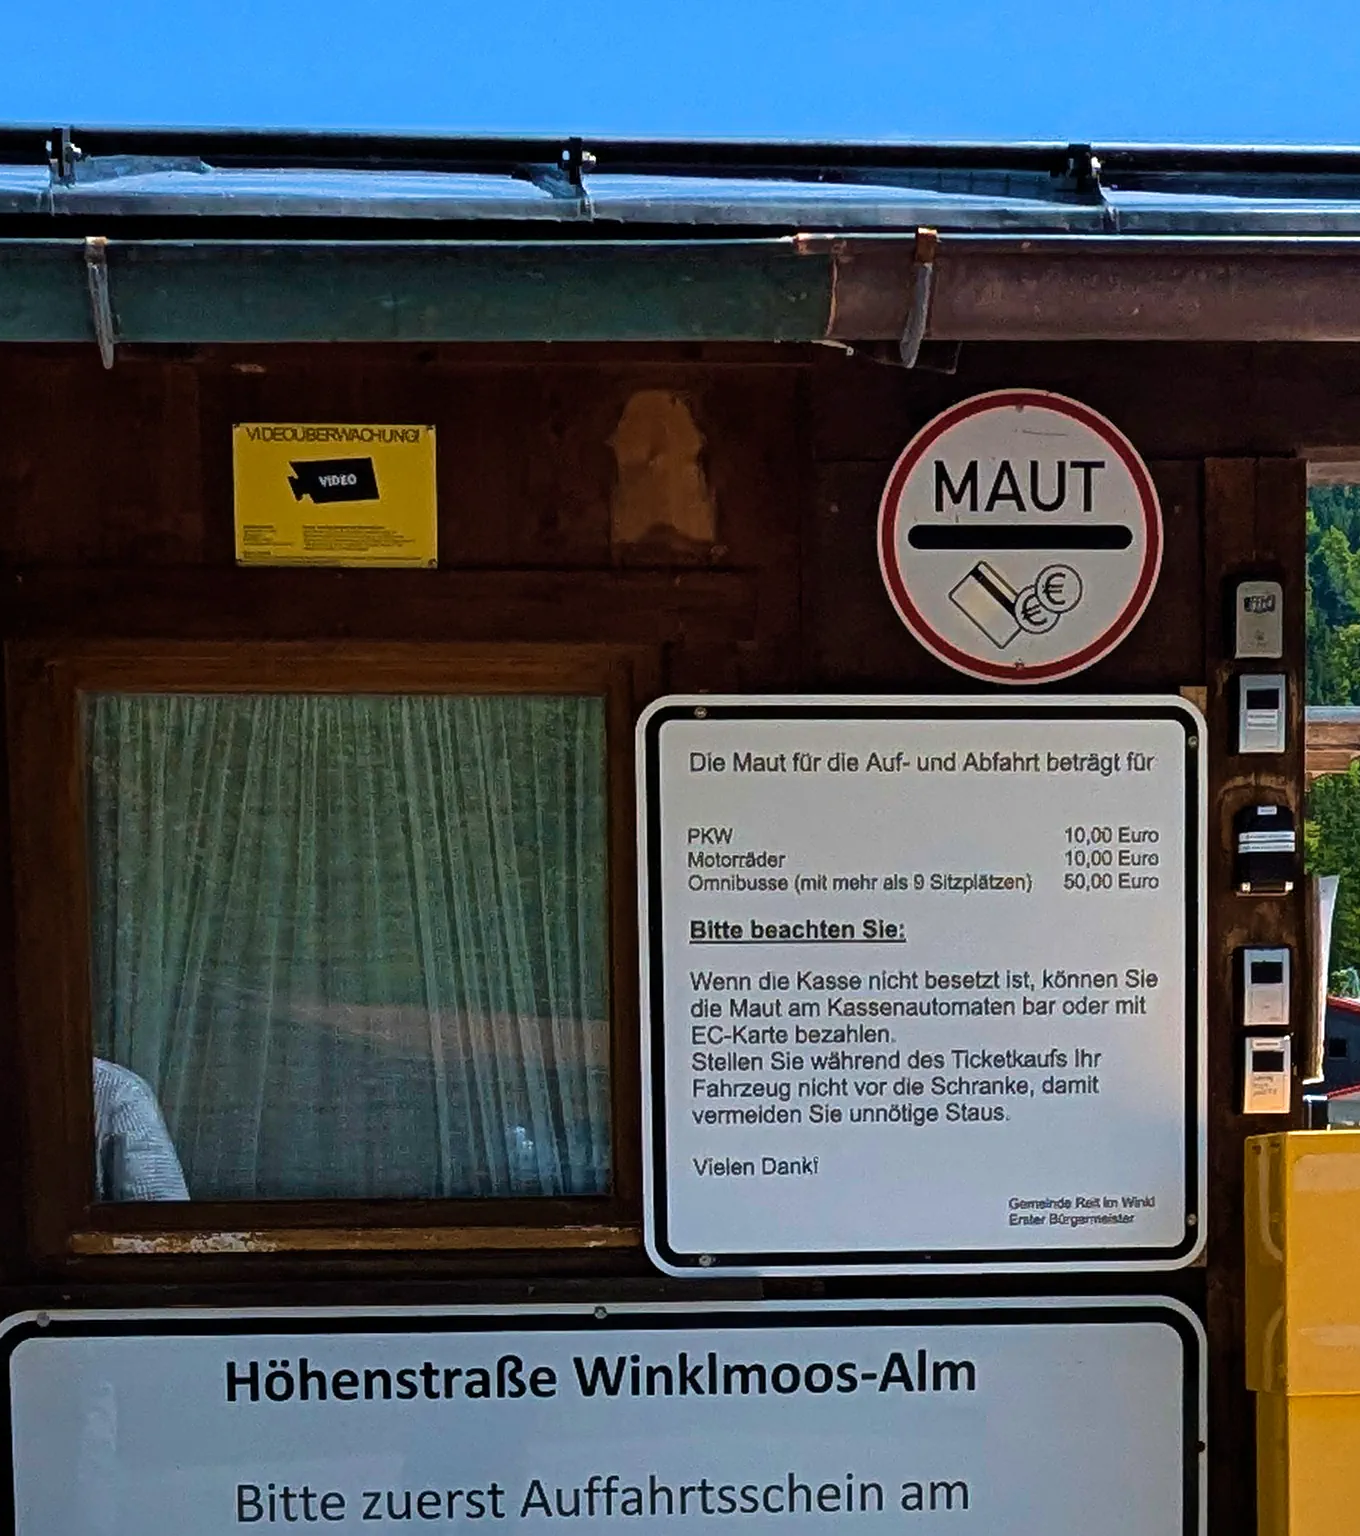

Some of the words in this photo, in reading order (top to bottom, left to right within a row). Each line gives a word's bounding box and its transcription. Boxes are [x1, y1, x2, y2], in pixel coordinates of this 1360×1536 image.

[318, 473, 358, 488] VIDEO
[933, 459, 1106, 513] MAUT
[689, 750, 726, 772] Die
[733, 750, 787, 772] Maut
[792, 750, 822, 773] für
[826, 751, 859, 772] die
[865, 751, 911, 773] Auf-
[917, 750, 957, 772] und
[962, 750, 1041, 772] Abfahrt
[1046, 751, 1121, 777] beträgt
[1126, 751, 1155, 772] für
[687, 827, 733, 845] PKW
[1063, 825, 1114, 848] 10,00
[1118, 825, 1160, 844] Euro
[687, 850, 787, 869] Motorräder
[1063, 849, 1114, 871] 10,00
[1118, 849, 1159, 867] Euro
[687, 872, 789, 891] Omnibusse
[794, 872, 828, 895] (mit
[832, 872, 879, 891] mehr
[882, 873, 909, 891] als
[913, 873, 925, 891] 9
[930, 872, 1033, 895] Sitzplätzen)
[1063, 872, 1113, 895] 50,00
[1118, 872, 1160, 890] Euro
[690, 919, 744, 940] Bitte
[750, 919, 855, 940] beachten
[862, 919, 907, 940] Sie:
[689, 970, 752, 991] Wenn
[758, 970, 790, 991] die
[796, 969, 863, 991] Kasse
[868, 969, 919, 991] nicht
[924, 969, 1001, 990] besetzt
[1006, 968, 1035, 995] ist,
[1042, 967, 1118, 989] können
[1125, 968, 1159, 989] Sie
[690, 997, 722, 1017] die
[729, 996, 783, 1018] Maut
[787, 1000, 821, 1017] am
[827, 994, 1016, 1018] Kassenautomaten
[1022, 995, 1057, 1016] bar
[1062, 994, 1110, 1016] oder
[1115, 994, 1147, 1015] mit
[691, 1023, 789, 1045] EC-Karte
[795, 1022, 897, 1045] bezahlen.
[691, 1050, 763, 1071] Stellen
[770, 1050, 805, 1071] Sie
[810, 1048, 900, 1071] während
[907, 1049, 945, 1070] des
[950, 1047, 1068, 1069] Ticketkaufs
[1074, 1048, 1102, 1068] Ihr
[692, 1077, 791, 1102] Fahrzeug
[798, 1076, 849, 1097] nicht
[853, 1081, 888, 1097] vor
[892, 1075, 925, 1096] die
[930, 1073, 1035, 1099] Schranke,
[1041, 1074, 1100, 1094] damit
[691, 1103, 802, 1125] vermeiden
[808, 1102, 843, 1123] Sie
[849, 1101, 939, 1127] unnötige
[945, 1101, 1011, 1122] Staus.
[692, 1155, 755, 1176] Vielen
[226, 1353, 557, 1402] Höhenstraße
[572, 1347, 976, 1397] Winklmoos-Alm
[237, 1481, 346, 1523] Bitte
[362, 1482, 506, 1521] zuerst
[519, 1471, 883, 1517] Auffahrtsschein
[901, 1480, 969, 1511] am
